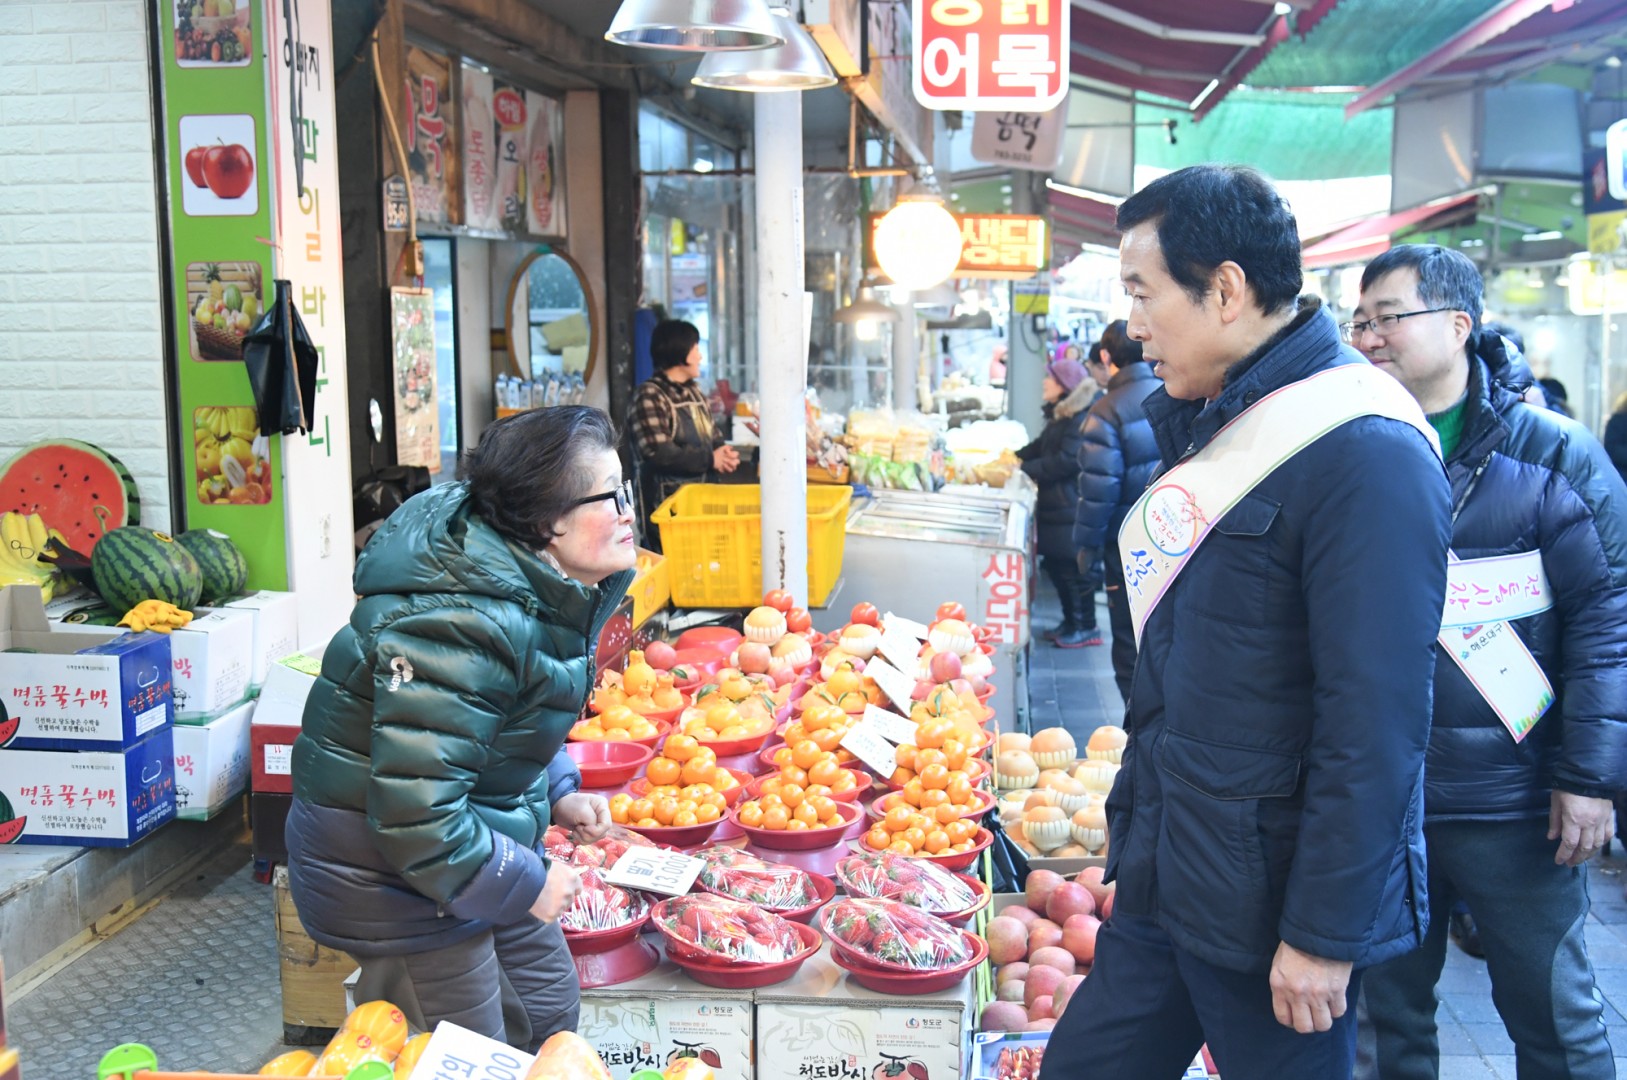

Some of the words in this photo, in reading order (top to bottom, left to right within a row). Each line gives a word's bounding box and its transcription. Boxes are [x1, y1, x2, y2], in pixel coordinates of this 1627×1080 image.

[923, 32, 1056, 97] 어묵
[404, 74, 446, 177] 묵
[963, 219, 1038, 265] 생닭
[982, 554, 1029, 644] 생닭
[626, 857, 660, 877] 딸기
